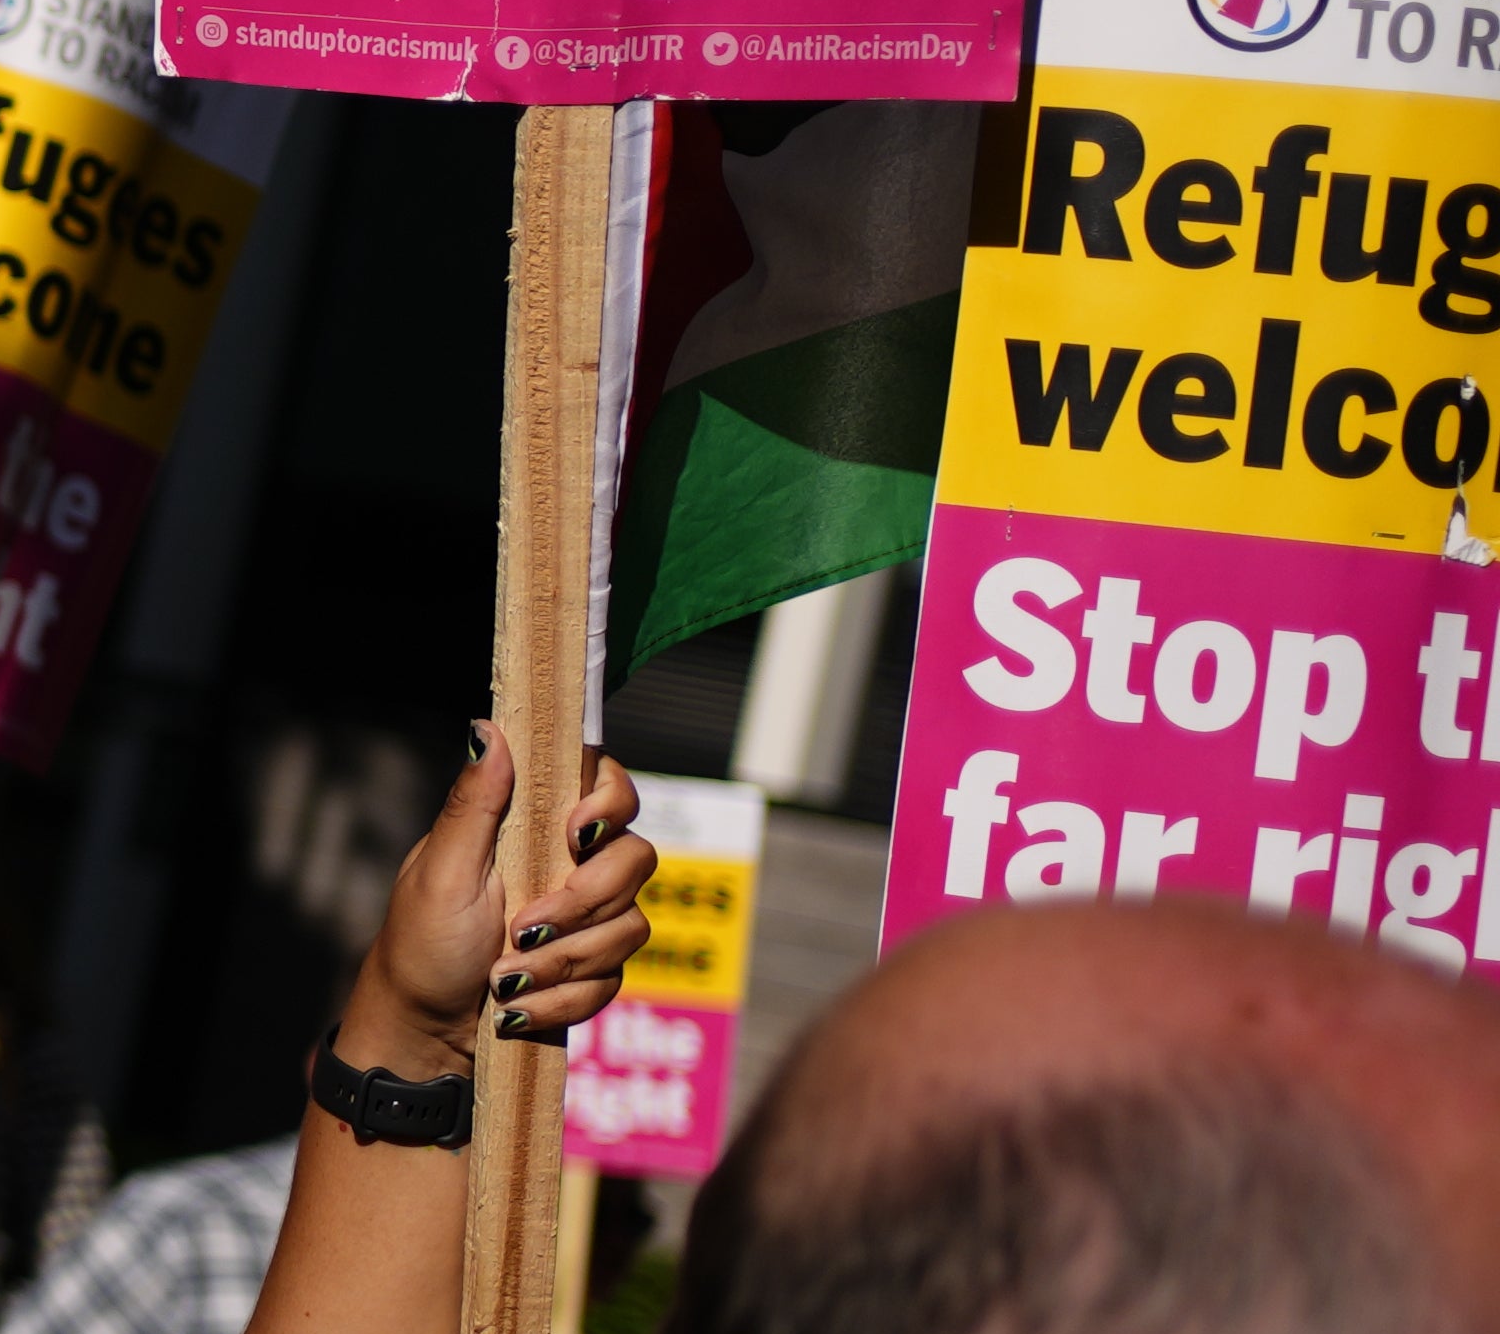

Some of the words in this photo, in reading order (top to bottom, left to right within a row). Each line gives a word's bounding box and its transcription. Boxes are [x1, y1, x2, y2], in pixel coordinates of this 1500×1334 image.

[234, 20, 480, 65] standuptoracismuk
[532, 33, 685, 67] @StandUTR
[741, 32, 974, 67] @AntiRacismDay
[1003, 317, 1500, 493] welco
[961, 556, 1368, 782] Stop
[1417, 608, 1500, 763] t
[943, 750, 1200, 905] far
[1247, 794, 1500, 979] rig
